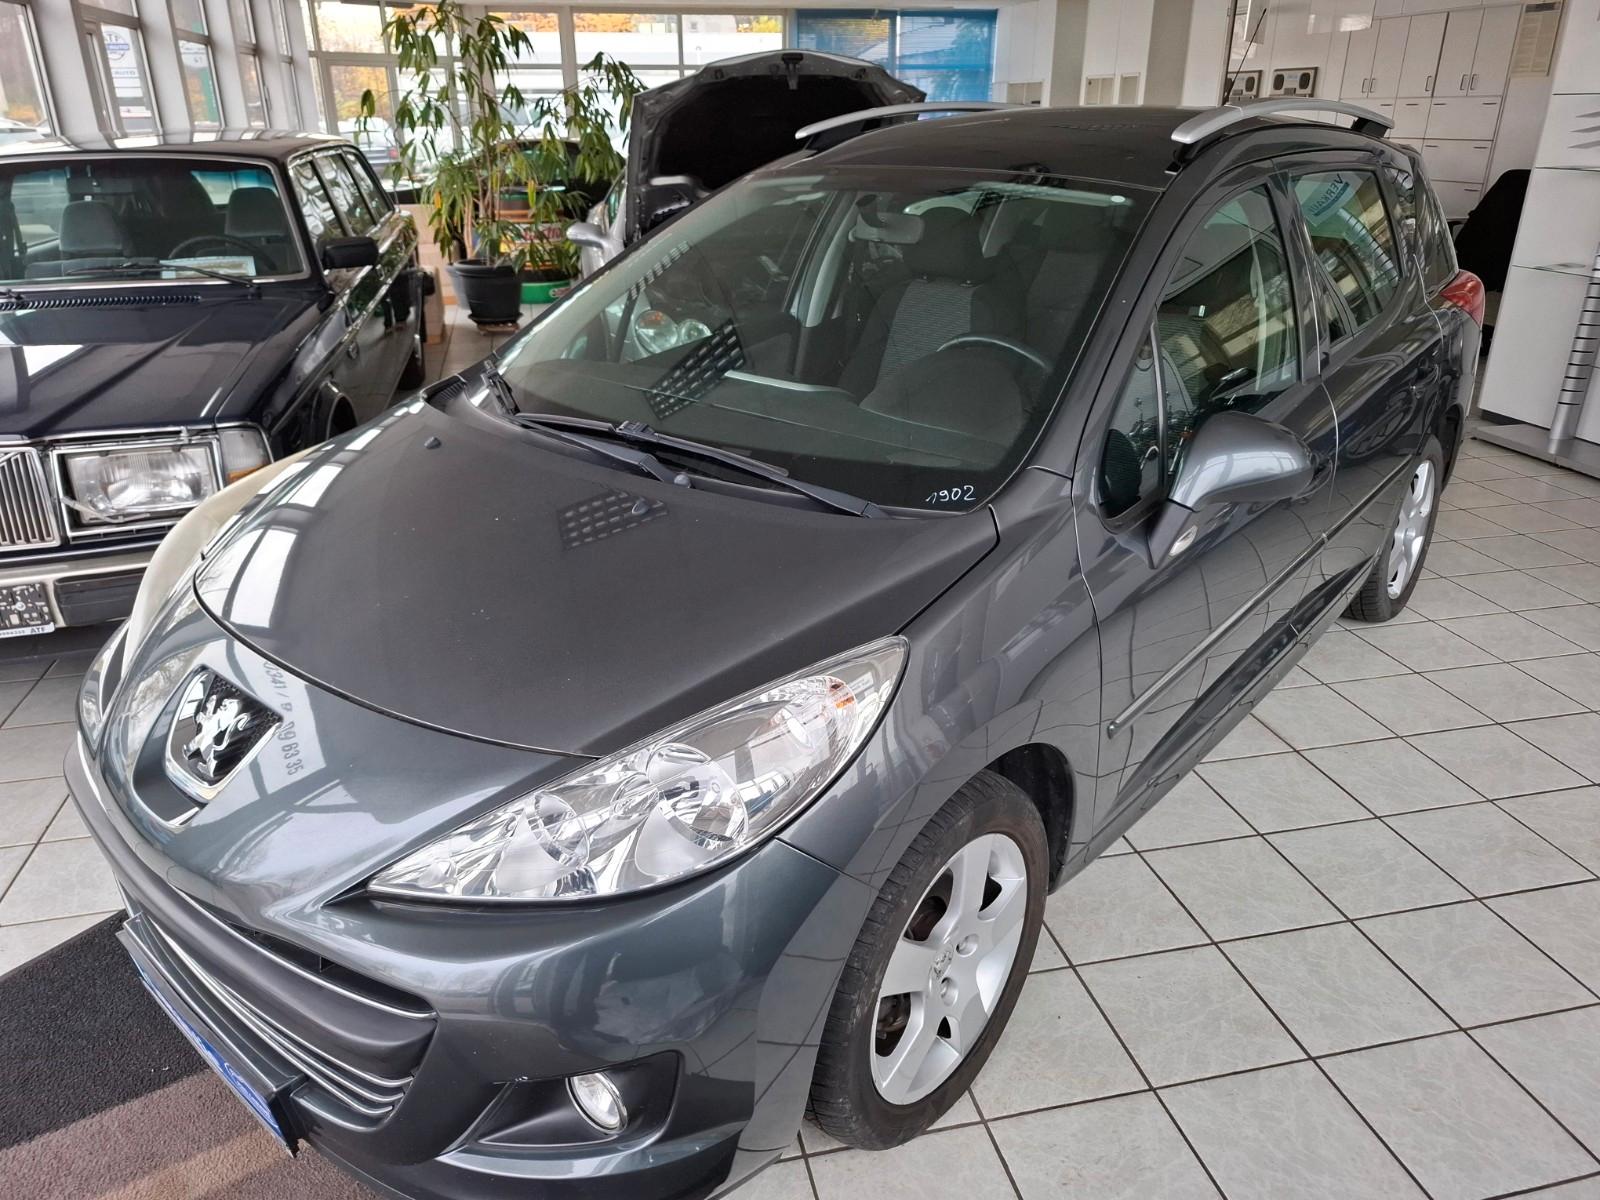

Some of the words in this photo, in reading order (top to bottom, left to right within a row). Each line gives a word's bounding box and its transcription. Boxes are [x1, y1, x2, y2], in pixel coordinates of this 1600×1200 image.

[925, 485, 976, 504] 1902
[282, 743, 300, 759] 63
[286, 758, 304, 776] 35
